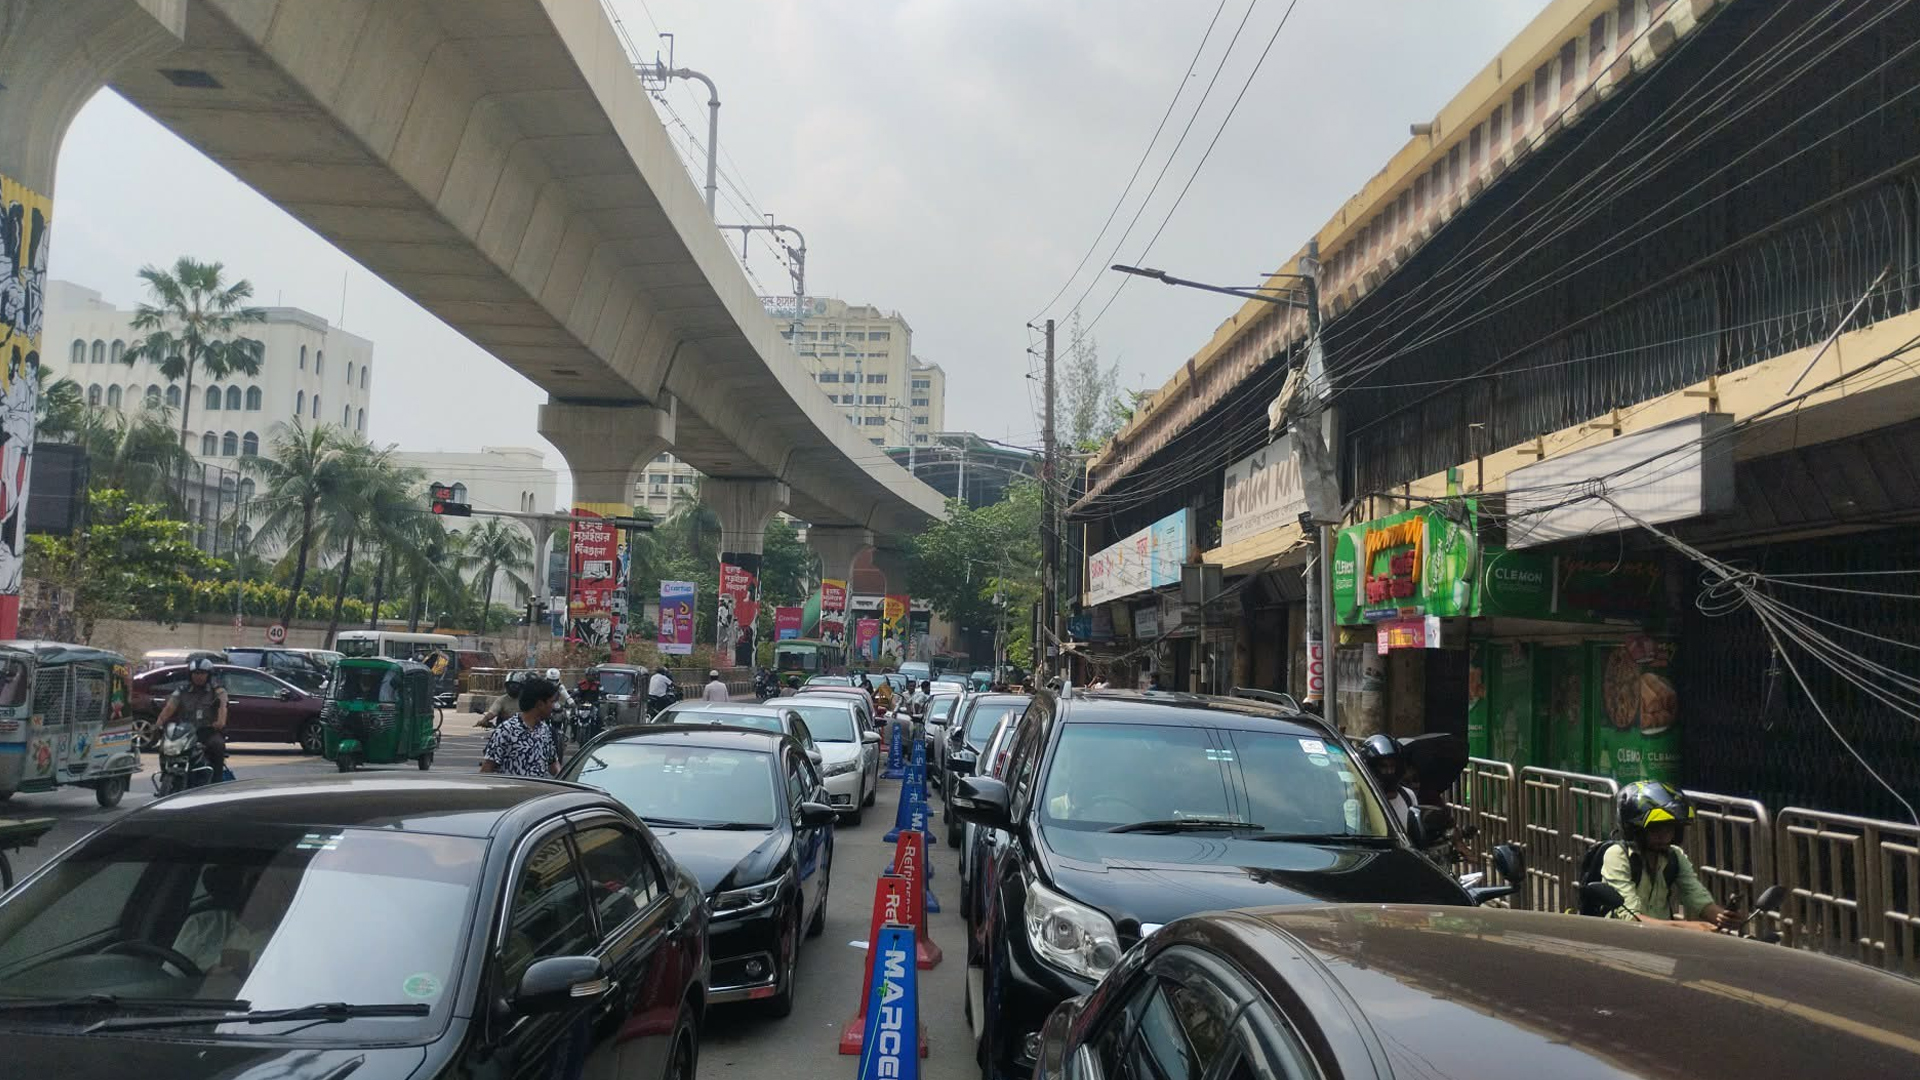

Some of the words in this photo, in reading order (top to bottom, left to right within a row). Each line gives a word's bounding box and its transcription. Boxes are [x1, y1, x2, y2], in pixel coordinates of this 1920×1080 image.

[1494, 568, 1542, 583] CLEMON
[270, 627, 283, 638] 40
[893, 734, 901, 756] Smart
[893, 758, 900, 768] TV
[877, 949, 907, 1080] MARCE
